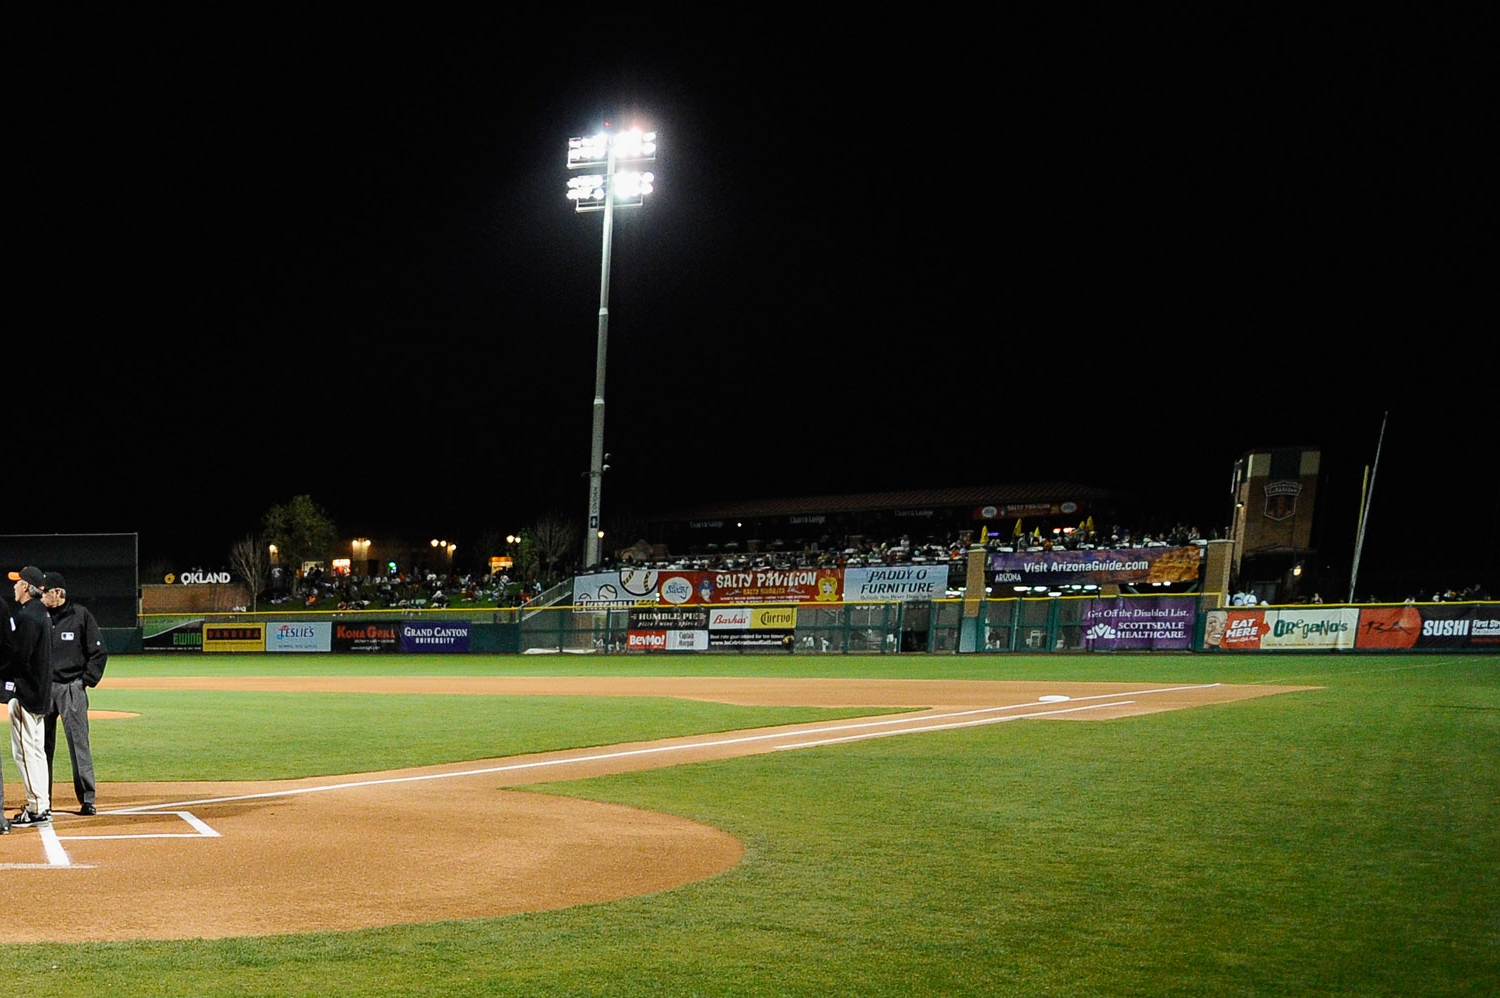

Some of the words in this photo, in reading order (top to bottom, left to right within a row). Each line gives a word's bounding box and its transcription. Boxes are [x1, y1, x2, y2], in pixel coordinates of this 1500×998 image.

[1024, 562, 1047, 573] Visit
[1051, 560, 1149, 573] ArizonaGuide.com
[716, 574, 753, 588] SALTY
[868, 569, 912, 582] PADDY
[995, 573, 1021, 582] ARIZONA
[861, 583, 934, 595] FURNITURE
[761, 612, 791, 625] Cuervo
[1119, 609, 1132, 617] the
[1134, 609, 1168, 617] Disabled
[1171, 608, 1189, 617] List.
[1118, 622, 1185, 630] SCOTTSDALE
[1231, 619, 1257, 629] EAT
[1423, 620, 1470, 636] SUSHI
[277, 625, 315, 639] LESLIE'S
[367, 625, 396, 638] GRILL
[404, 627, 433, 637] GRAND
[434, 627, 468, 637] CANYON
[1226, 628, 1258, 638] HERE
[629, 634, 665, 645] BevMo!
